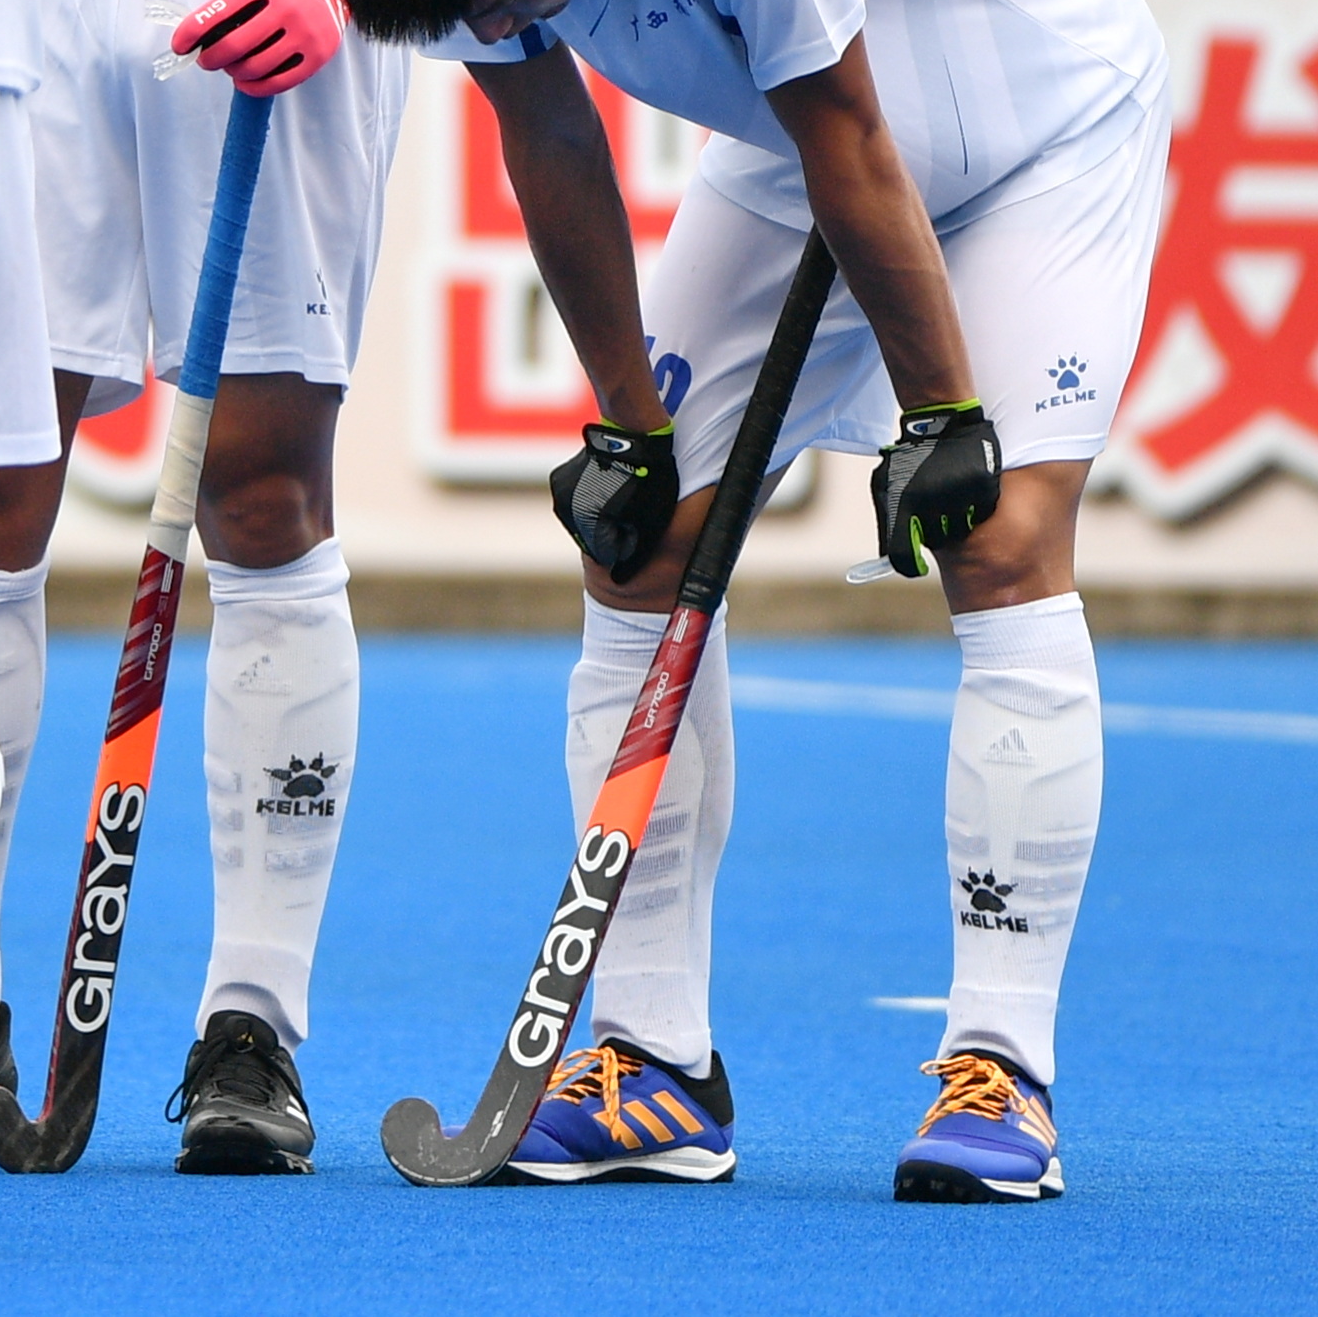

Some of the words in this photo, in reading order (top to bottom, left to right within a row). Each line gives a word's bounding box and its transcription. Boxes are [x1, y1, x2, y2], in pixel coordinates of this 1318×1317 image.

[1035, 389, 1097, 414] KELME
[143, 622, 163, 682] GR7000
[644, 671, 670, 729] GR7000
[256, 798, 336, 817] KELME
[960, 911, 1029, 934] KELME
